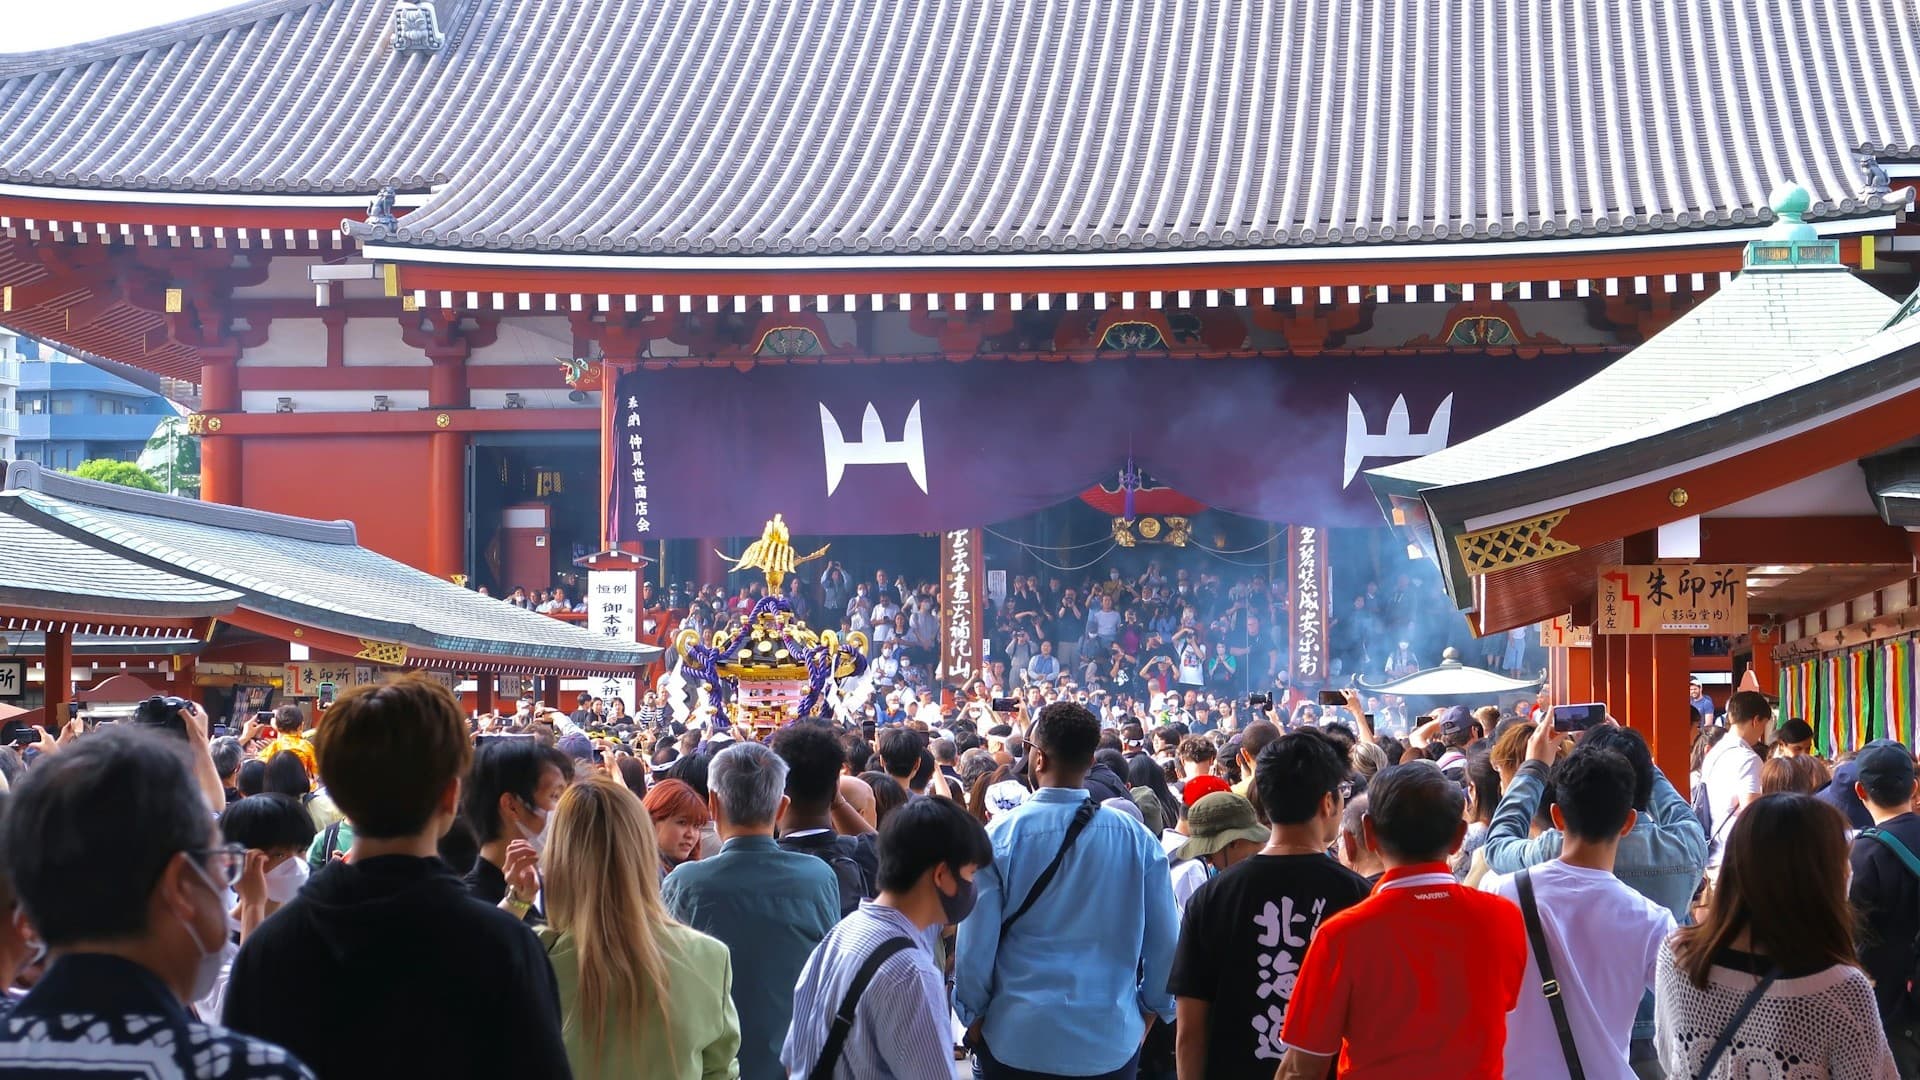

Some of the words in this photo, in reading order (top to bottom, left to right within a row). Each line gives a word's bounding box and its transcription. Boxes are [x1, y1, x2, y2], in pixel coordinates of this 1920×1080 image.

[629, 434, 651, 532] 仲見世商店会
[596, 584, 627, 595] 恒例
[1646, 568, 1740, 608] 朱印所
[602, 602, 622, 637] 御本尊
[1605, 585, 1617, 629] この先左
[303, 667, 351, 684] 朱印所
